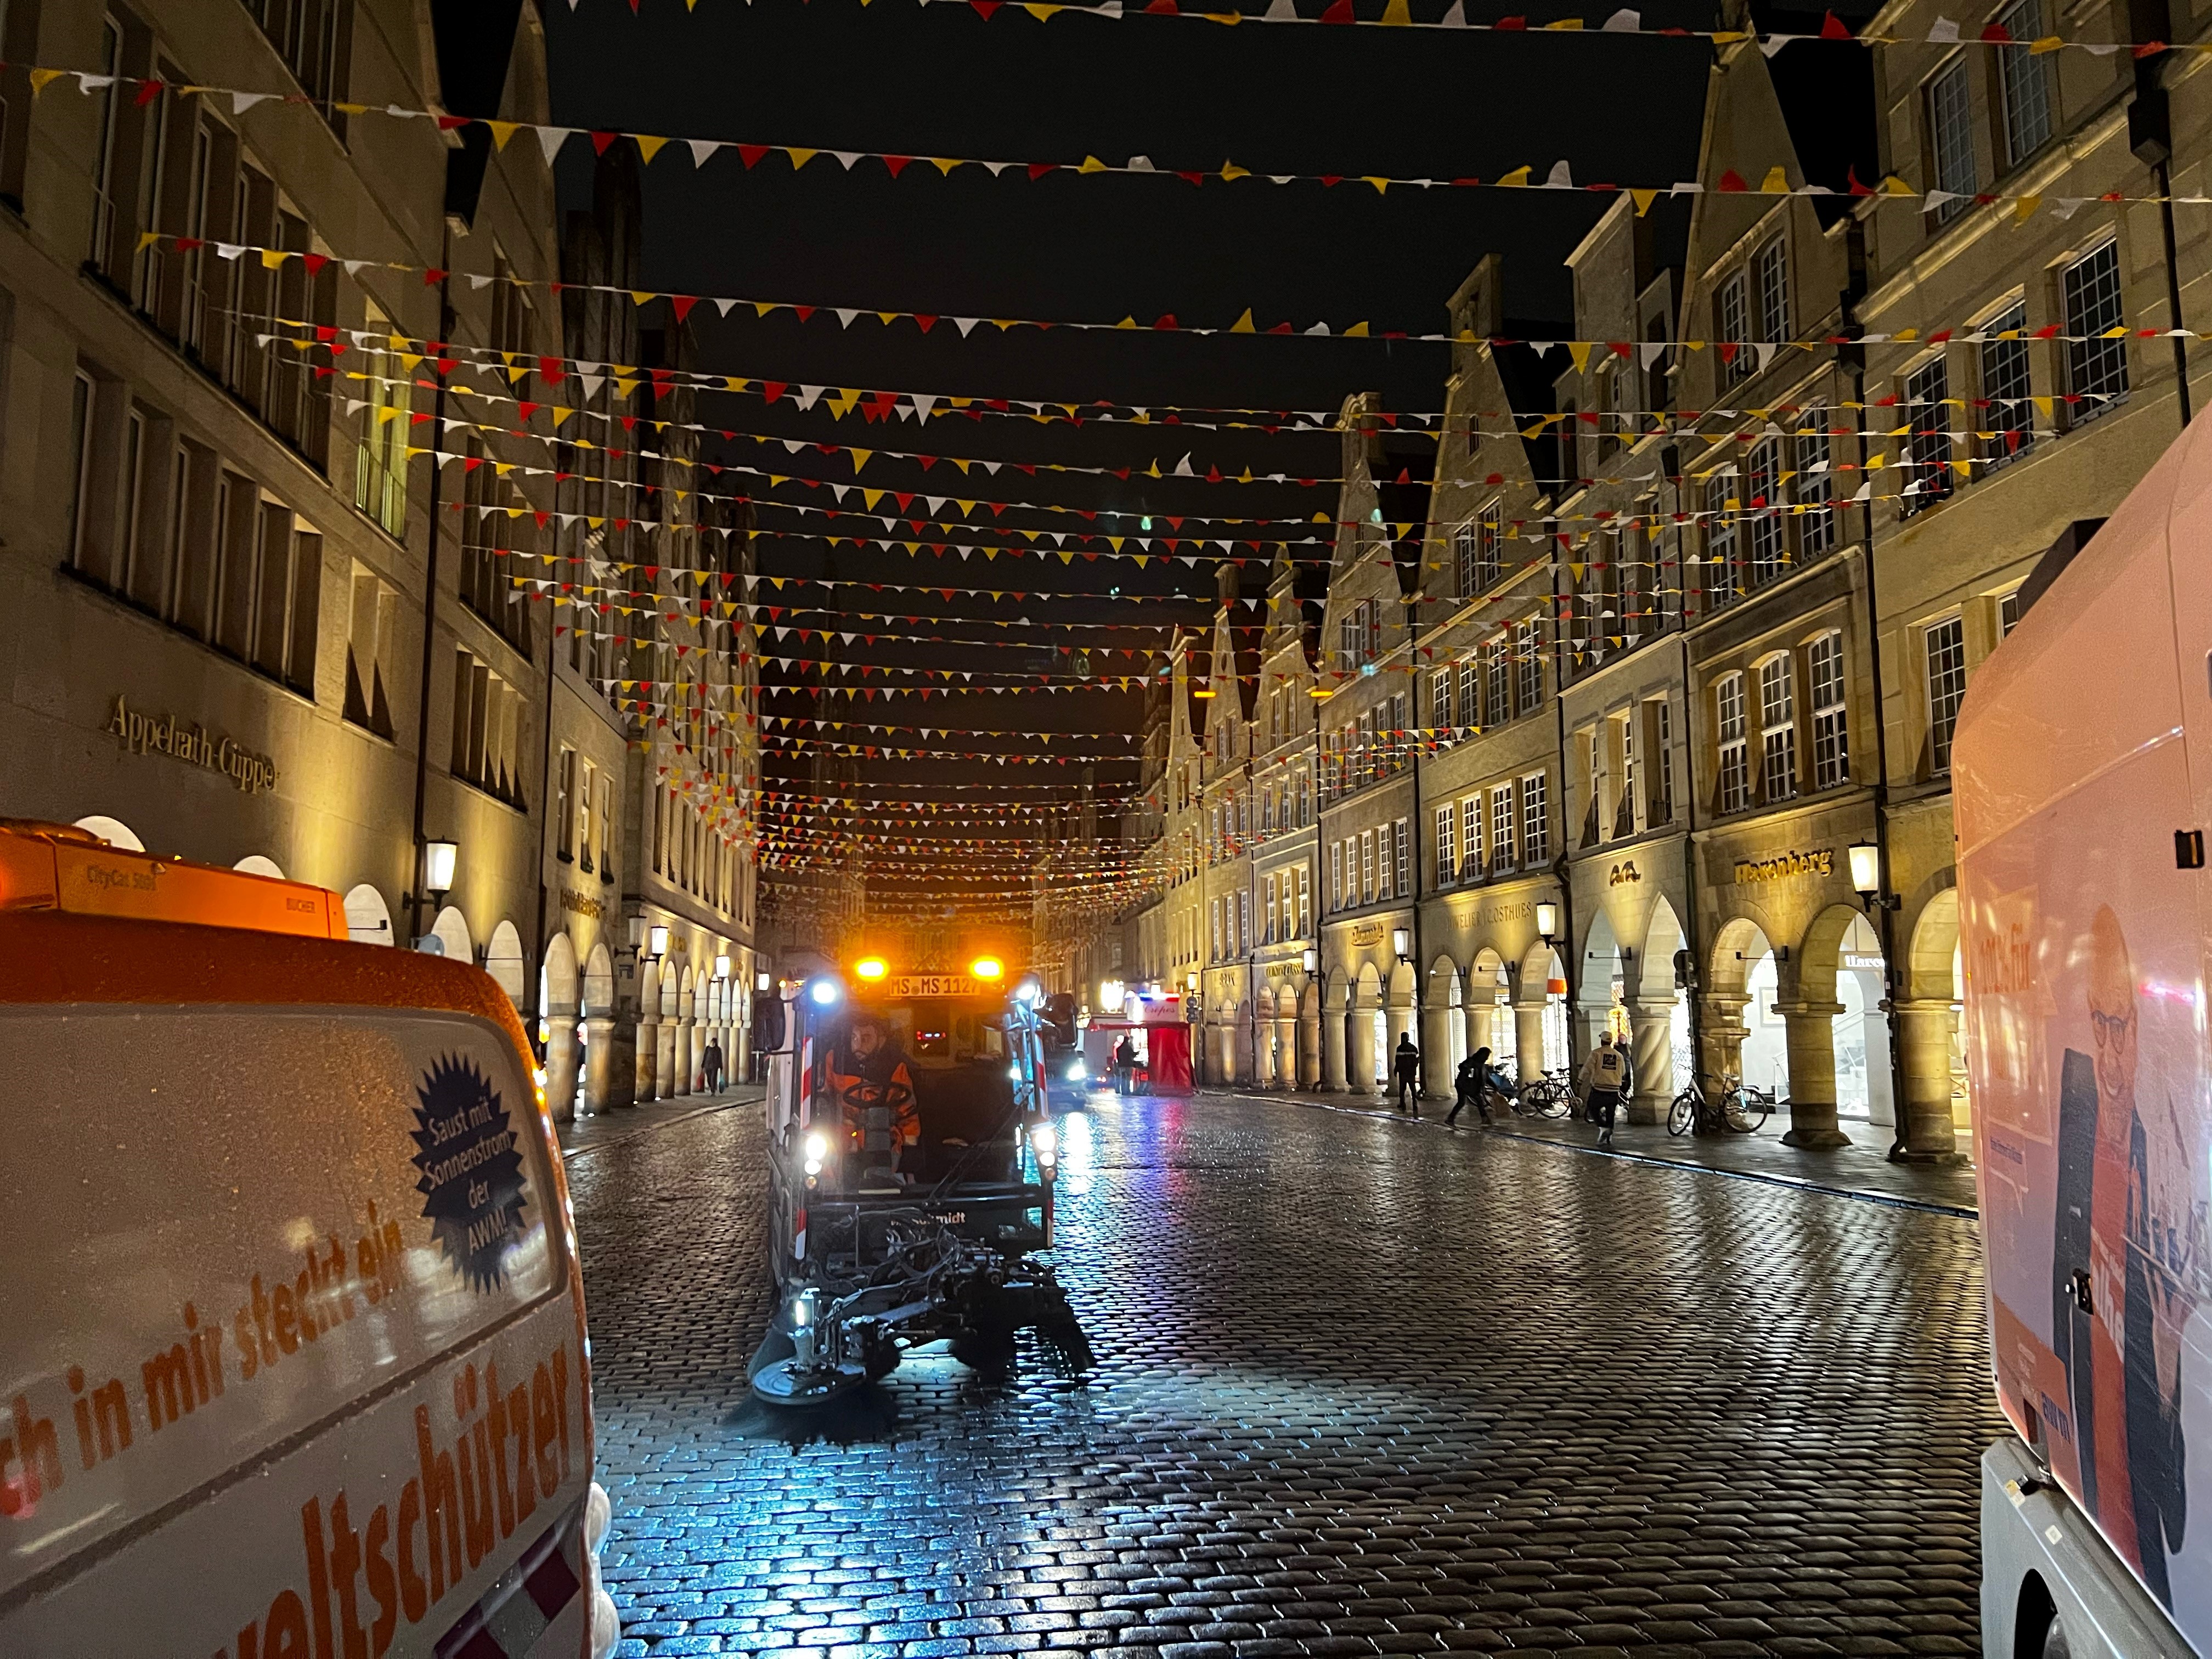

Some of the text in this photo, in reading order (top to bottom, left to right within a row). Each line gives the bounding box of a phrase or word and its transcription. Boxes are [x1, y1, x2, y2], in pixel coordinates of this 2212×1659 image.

[1735, 850, 1832, 885] Harenberg
[891, 978, 979, 995] MS MS 1127
[428, 1097, 493, 1146] Saust mit
[424, 1130, 512, 1190] Sonnenstrom
[468, 1177, 490, 1210] der
[469, 1207, 508, 1256] AWM!
[67, 1364, 134, 1470] in
[142, 1300, 225, 1433] mir
[235, 1233, 356, 1380] steckt
[358, 1198, 404, 1305] ein
[214, 1340, 569, 1659] ltschützer
